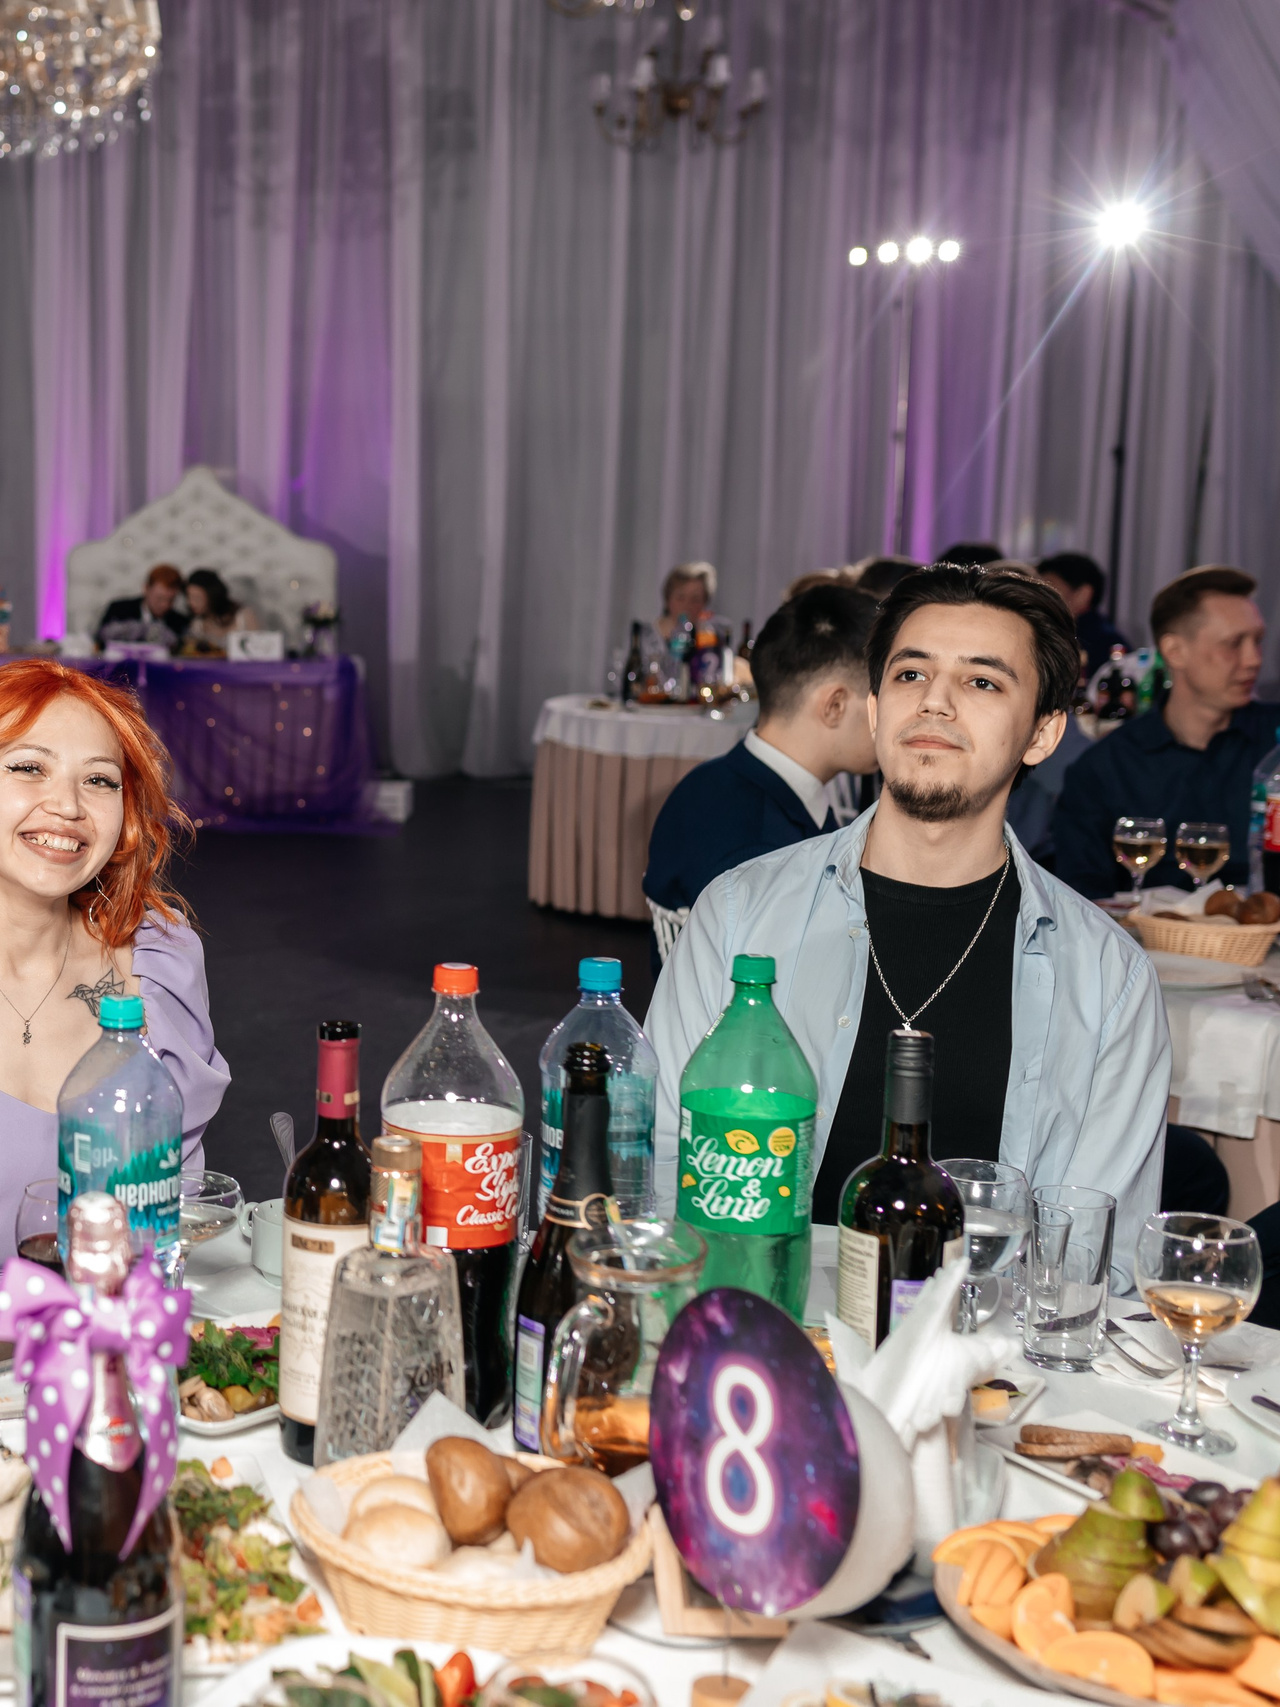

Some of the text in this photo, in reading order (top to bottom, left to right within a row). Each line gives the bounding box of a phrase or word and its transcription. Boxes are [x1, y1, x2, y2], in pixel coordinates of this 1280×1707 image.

[686, 1135, 784, 1182] Lemon
[691, 1178, 771, 1222] Lime
[740, 1178, 762, 1198] &
[706, 1364, 774, 1536] 8
